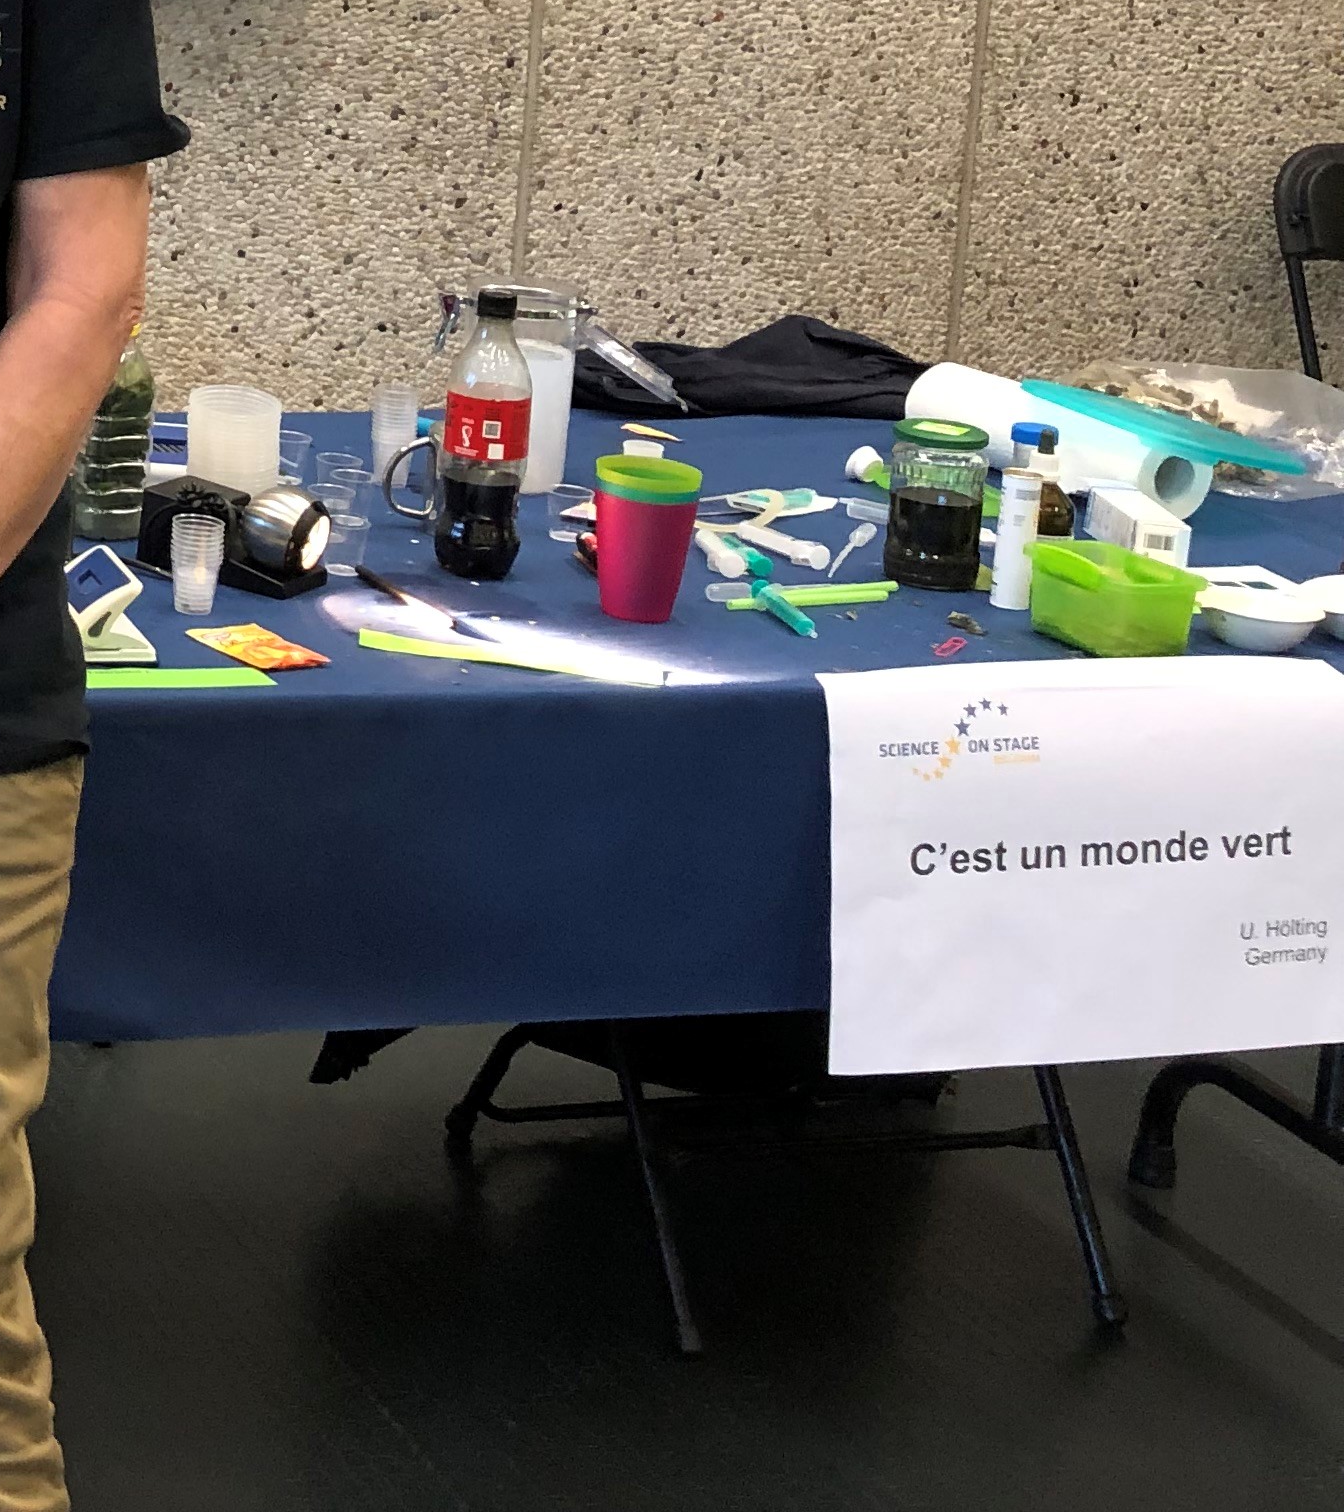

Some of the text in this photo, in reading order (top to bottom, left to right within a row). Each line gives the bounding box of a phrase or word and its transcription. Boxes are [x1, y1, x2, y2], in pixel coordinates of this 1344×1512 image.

[879, 736, 1040, 758] SCIENCE ON STAGE
[910, 825, 1292, 876] C’est un monde vert
[1239, 917, 1328, 941] U. Hölting
[1244, 945, 1328, 967] Germany
